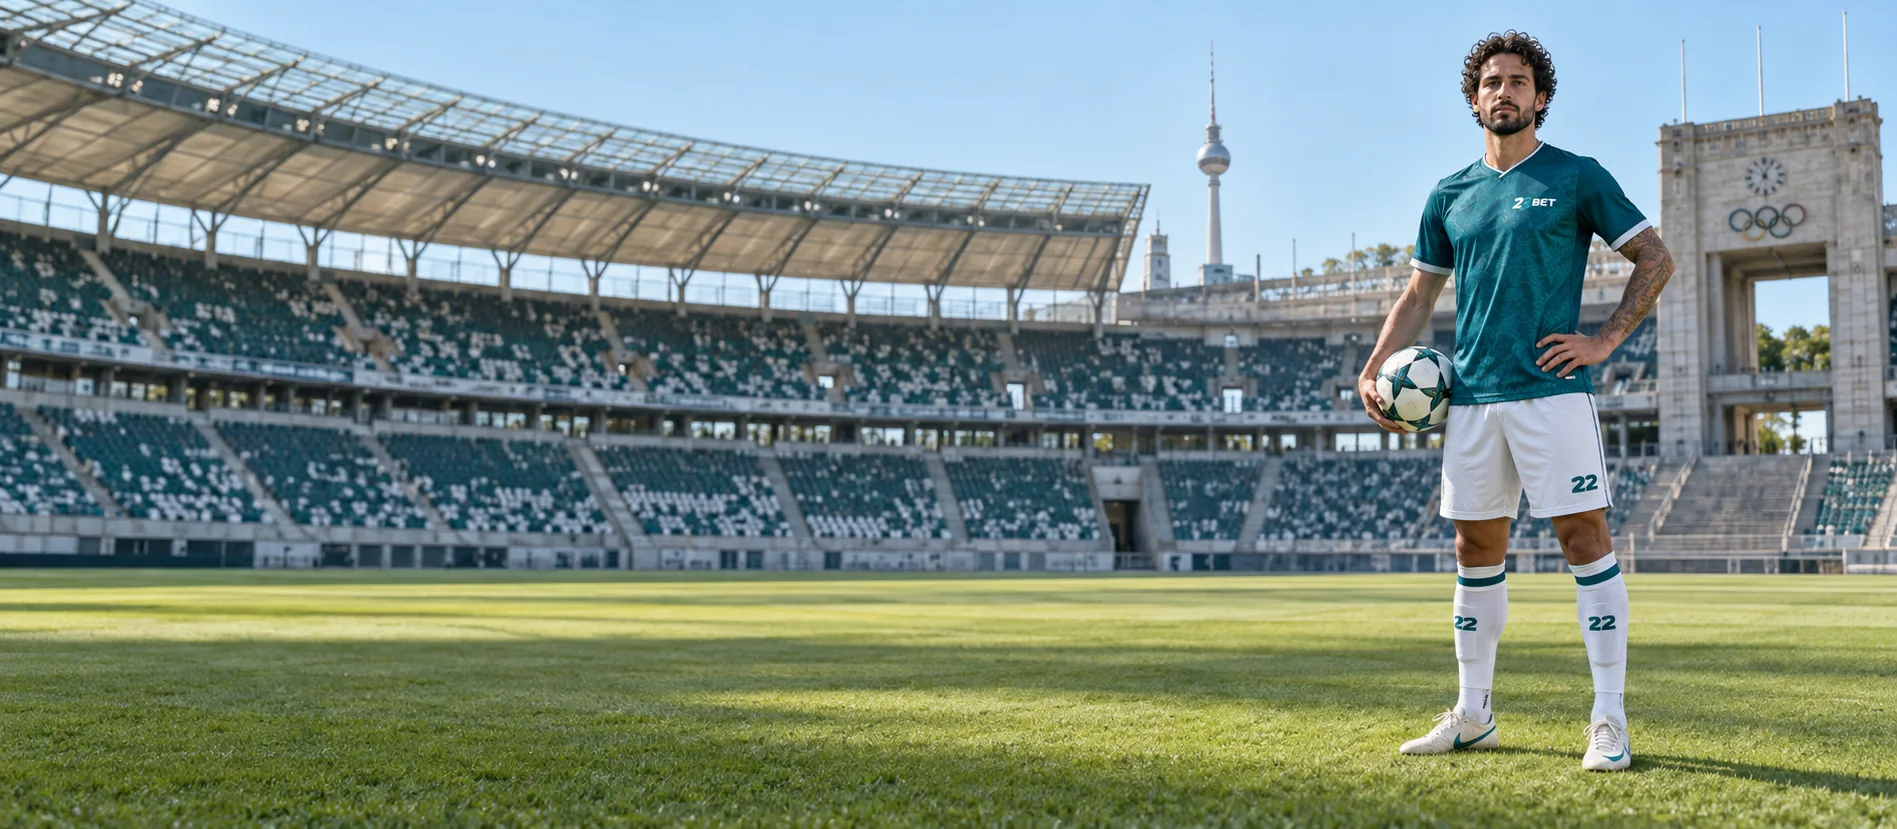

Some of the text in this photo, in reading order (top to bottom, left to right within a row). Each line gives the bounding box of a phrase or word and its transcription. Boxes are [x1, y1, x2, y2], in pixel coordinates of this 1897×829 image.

[1571, 474, 1598, 493] 22
[1454, 616, 1477, 631] 22
[1588, 615, 1616, 631] 22
